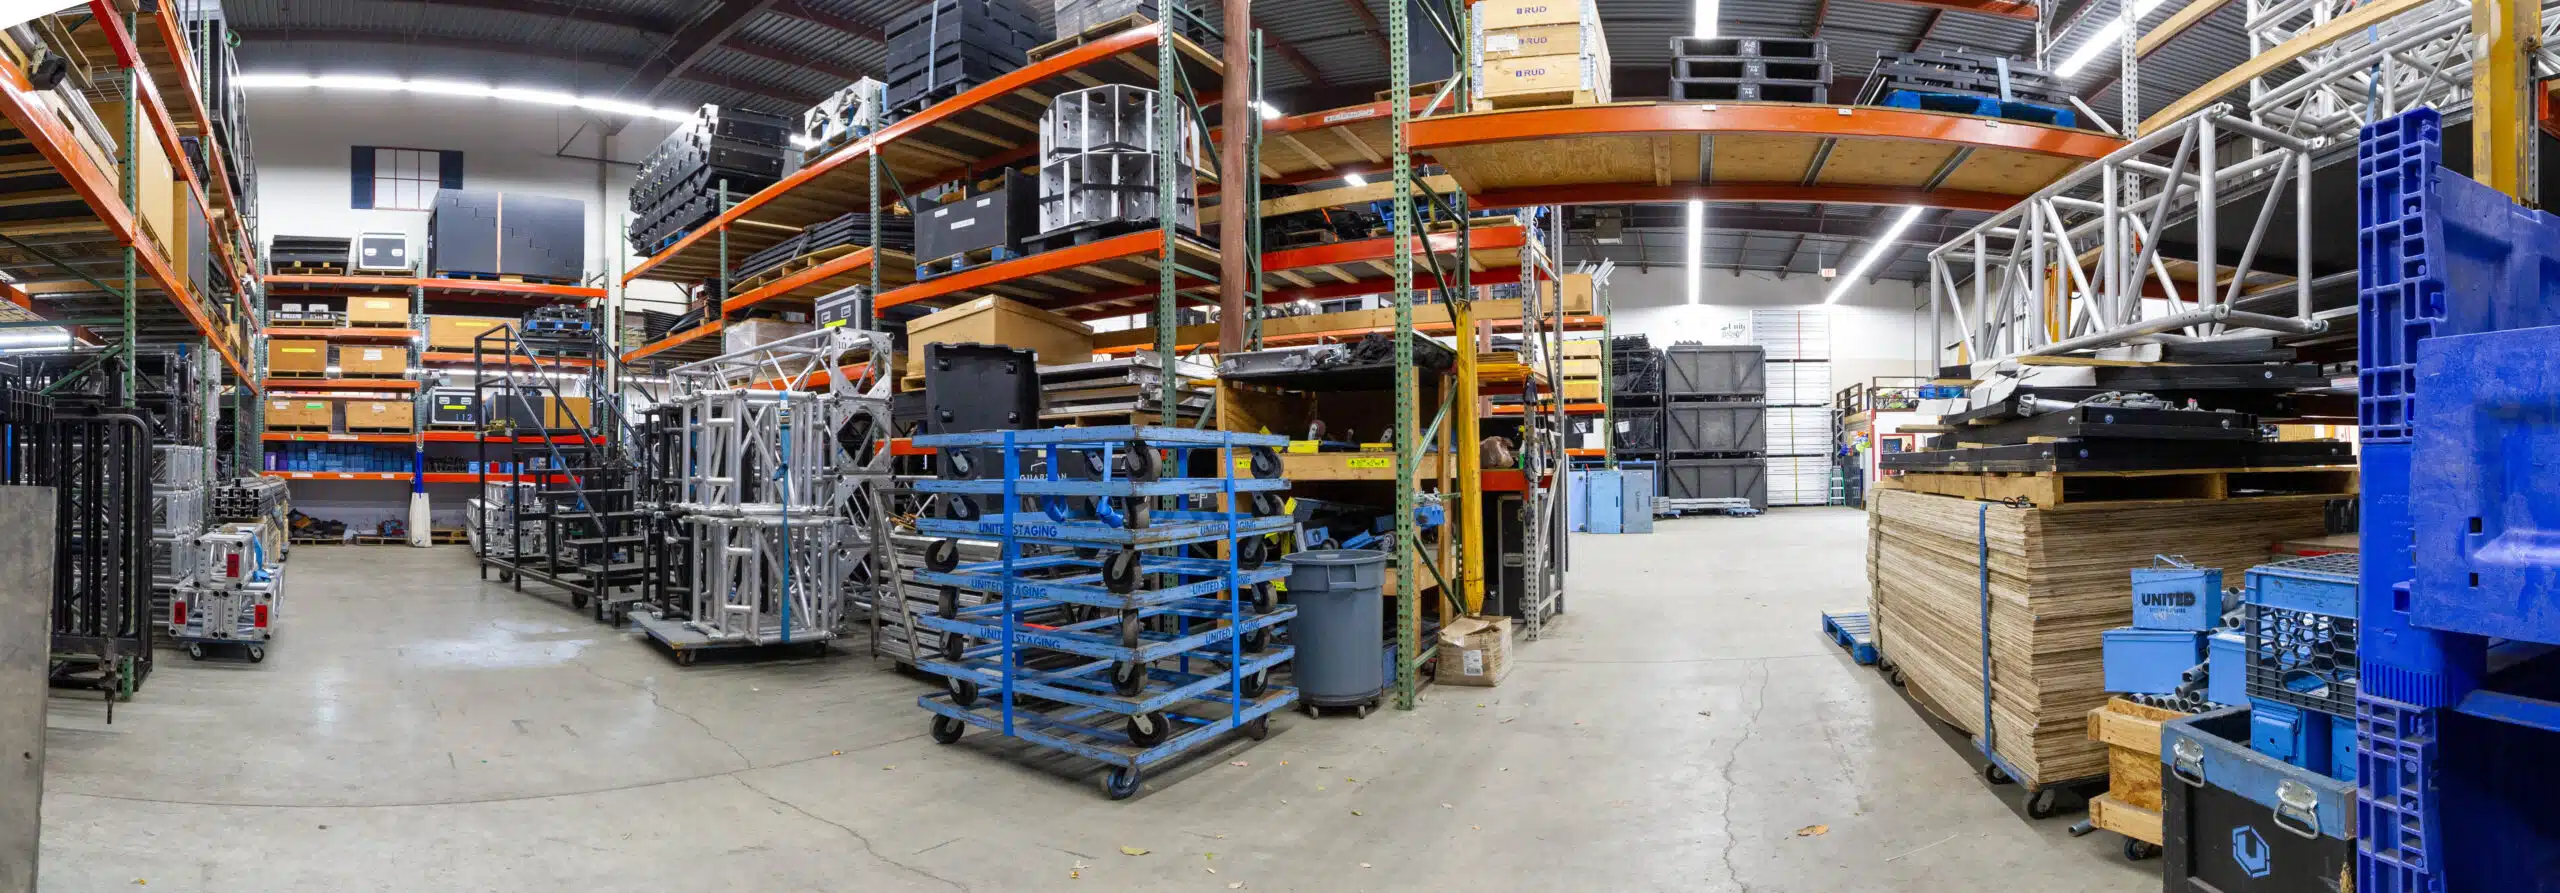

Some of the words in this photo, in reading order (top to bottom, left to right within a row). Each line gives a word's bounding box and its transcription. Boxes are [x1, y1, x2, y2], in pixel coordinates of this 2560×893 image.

[1524, 6, 1547, 14] RUD
[1523, 68, 1546, 77] RUD
[979, 523, 1005, 534] UNITE
[1013, 525, 1058, 537] STAGING
[1192, 580, 1219, 595] UNITED
[2141, 591, 2196, 607] UNITED
[1015, 633, 1061, 649] STAGING
[1205, 628, 1231, 645] UNITED
